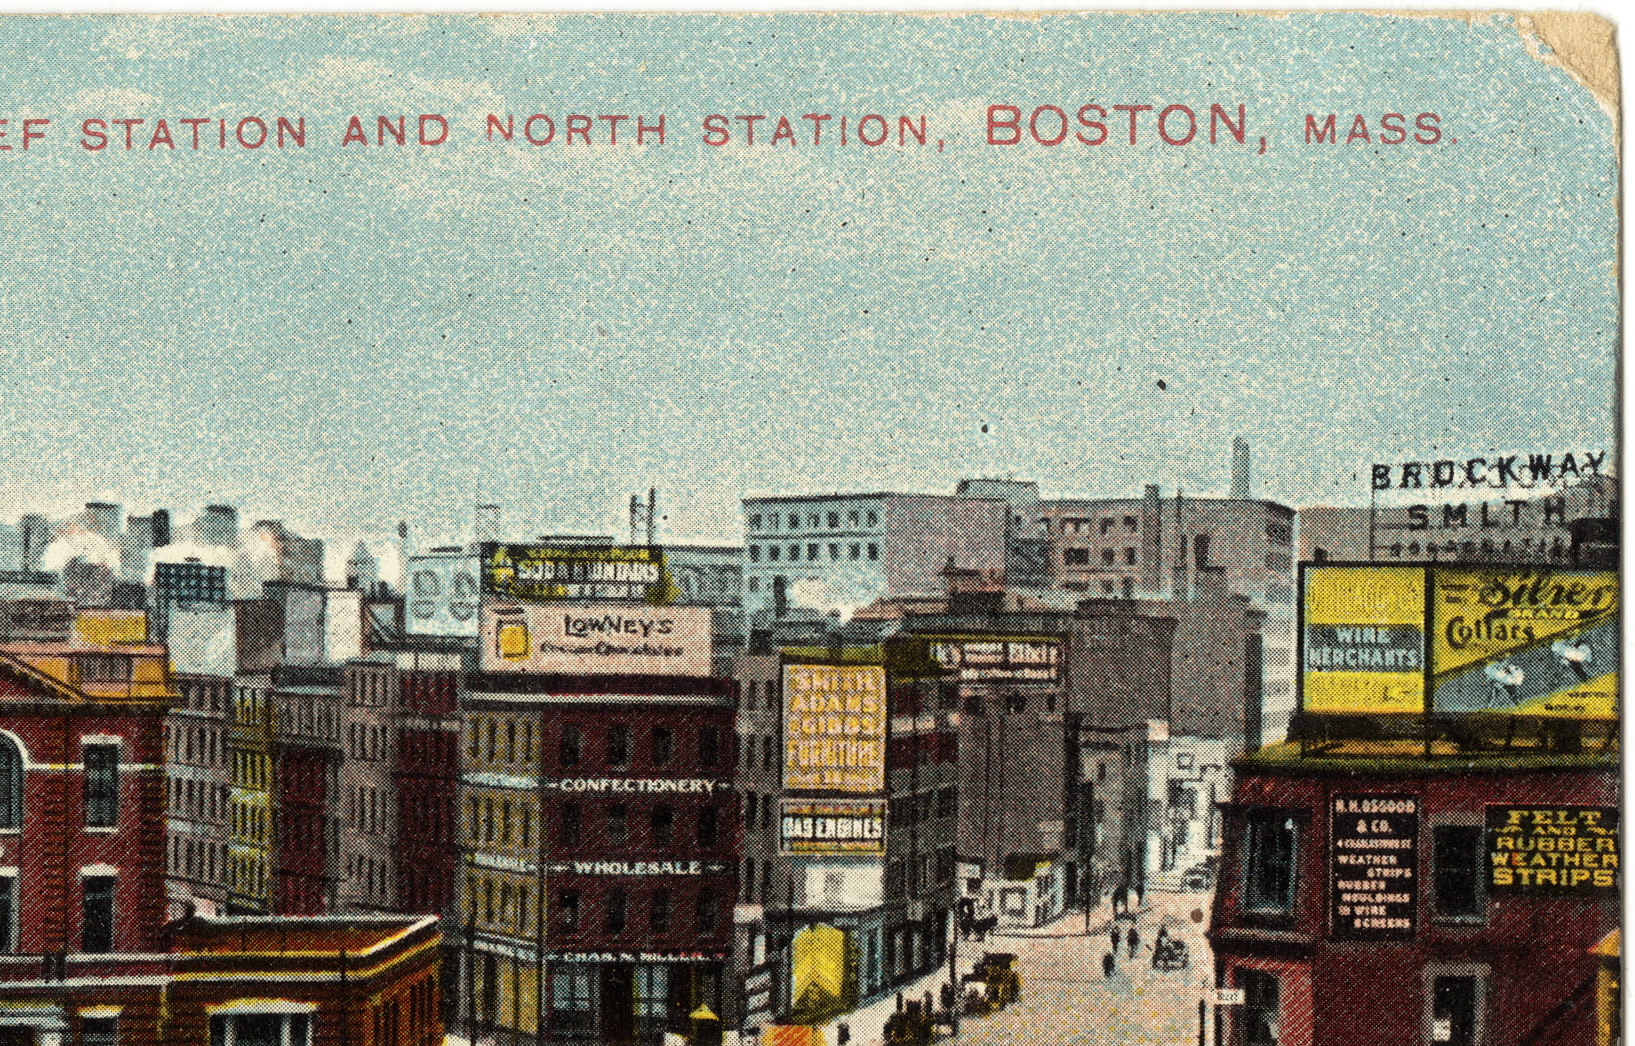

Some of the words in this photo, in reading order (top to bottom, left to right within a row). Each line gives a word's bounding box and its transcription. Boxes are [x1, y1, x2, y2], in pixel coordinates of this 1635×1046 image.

[1309, 647, 1419, 666] MERCHANTS
[789, 695, 879, 713] ADAMS
[560, 779, 716, 794] CONFECTIONERY
[1505, 810, 1602, 826] FELT
[1356, 818, 1368, 834] &
[1532, 826, 1577, 836] AND
[1496, 836, 1615, 852] RUBBER
[1337, 854, 1398, 866] WEATHER
[1490, 851, 1619, 868] WEATHER
[574, 861, 702, 875] WHOLESALE
[1366, 867, 1413, 879] STRIPS
[1492, 868, 1614, 887] STRIPS
[1353, 905, 1387, 916] WIRE
[1353, 918, 1411, 929] SCREENS
